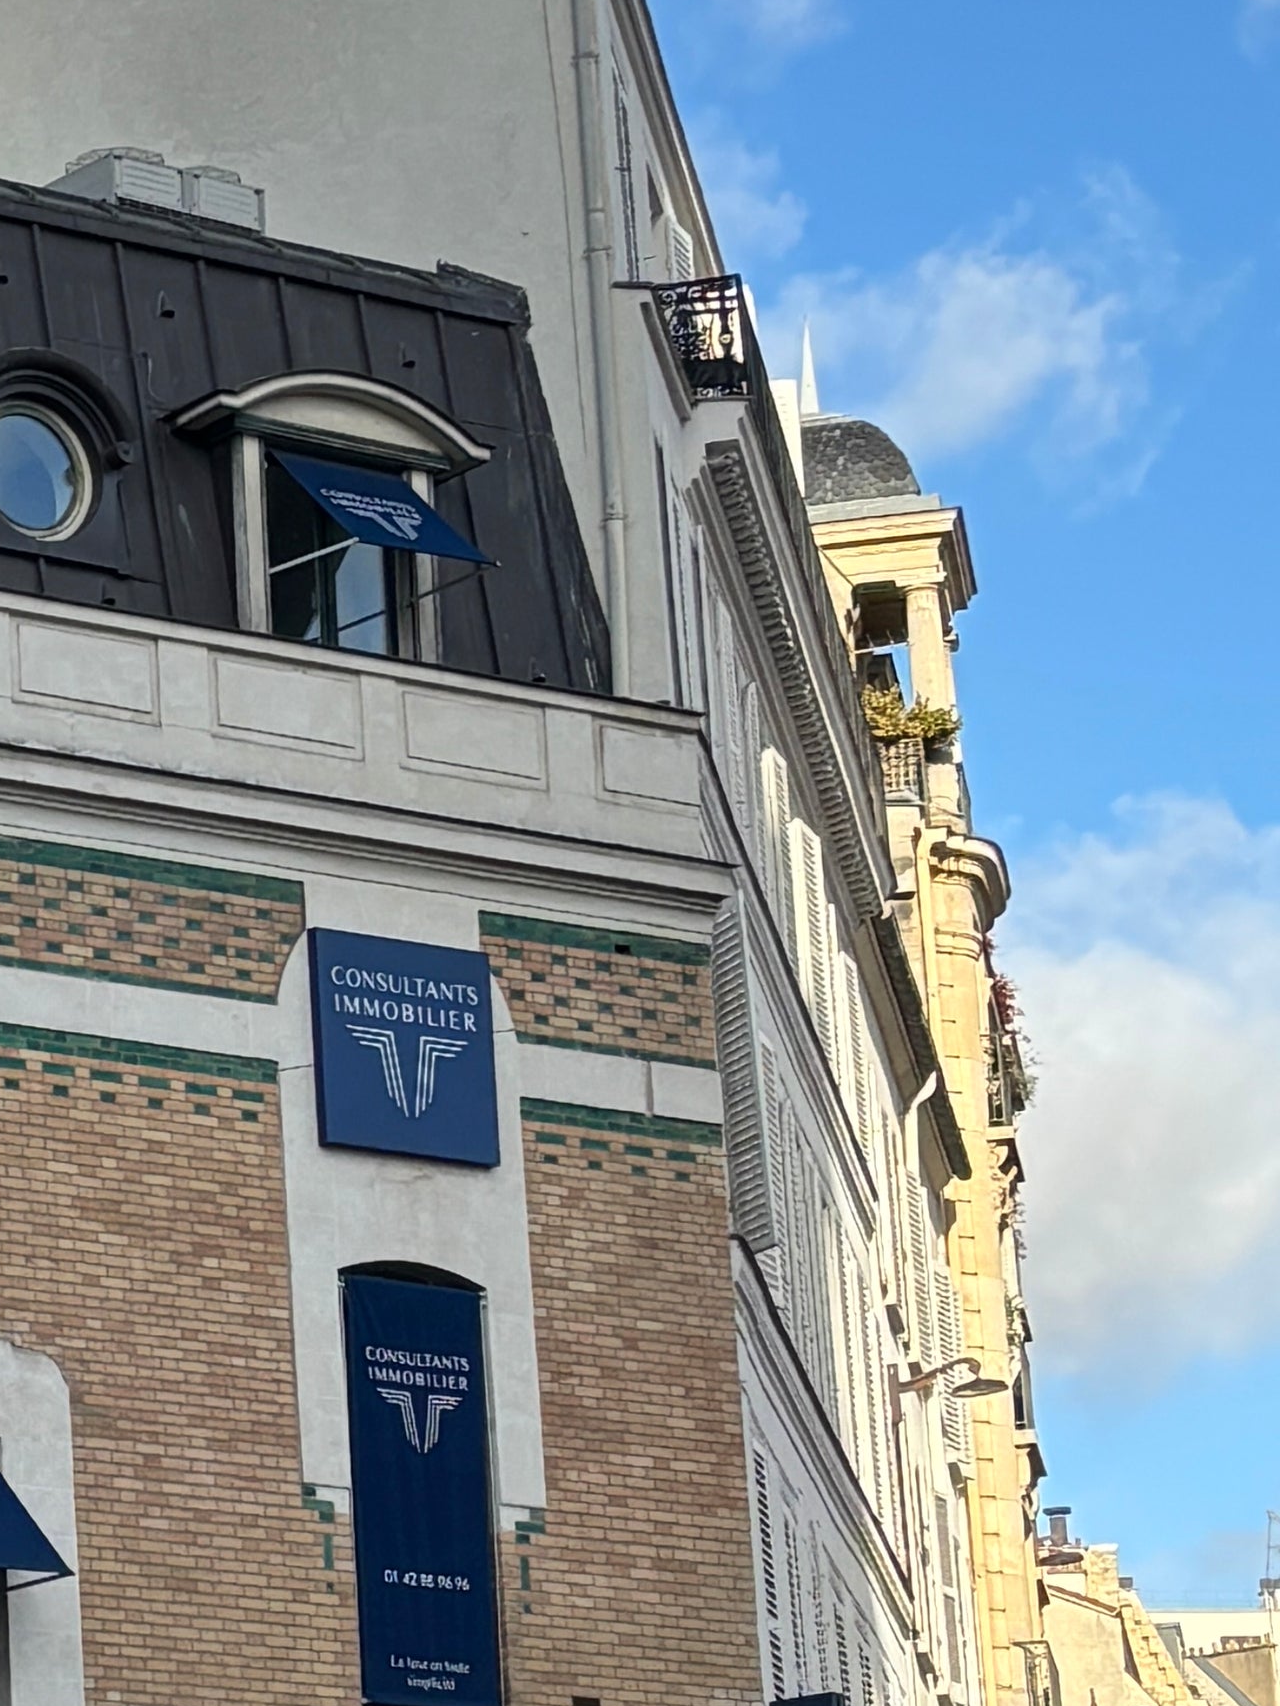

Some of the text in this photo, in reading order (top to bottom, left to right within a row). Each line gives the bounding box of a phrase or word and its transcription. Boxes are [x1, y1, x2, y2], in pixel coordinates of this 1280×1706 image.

[331, 966, 478, 1005] CONSULTANTS
[334, 993, 476, 1032] IMMOBILIER
[365, 1346, 469, 1371] CONSULTANTS
[368, 1366, 468, 1390] IMMOBILIER
[384, 1569, 398, 1583] 01
[402, 1572, 417, 1586] 42
[454, 1577, 469, 1590] 96
